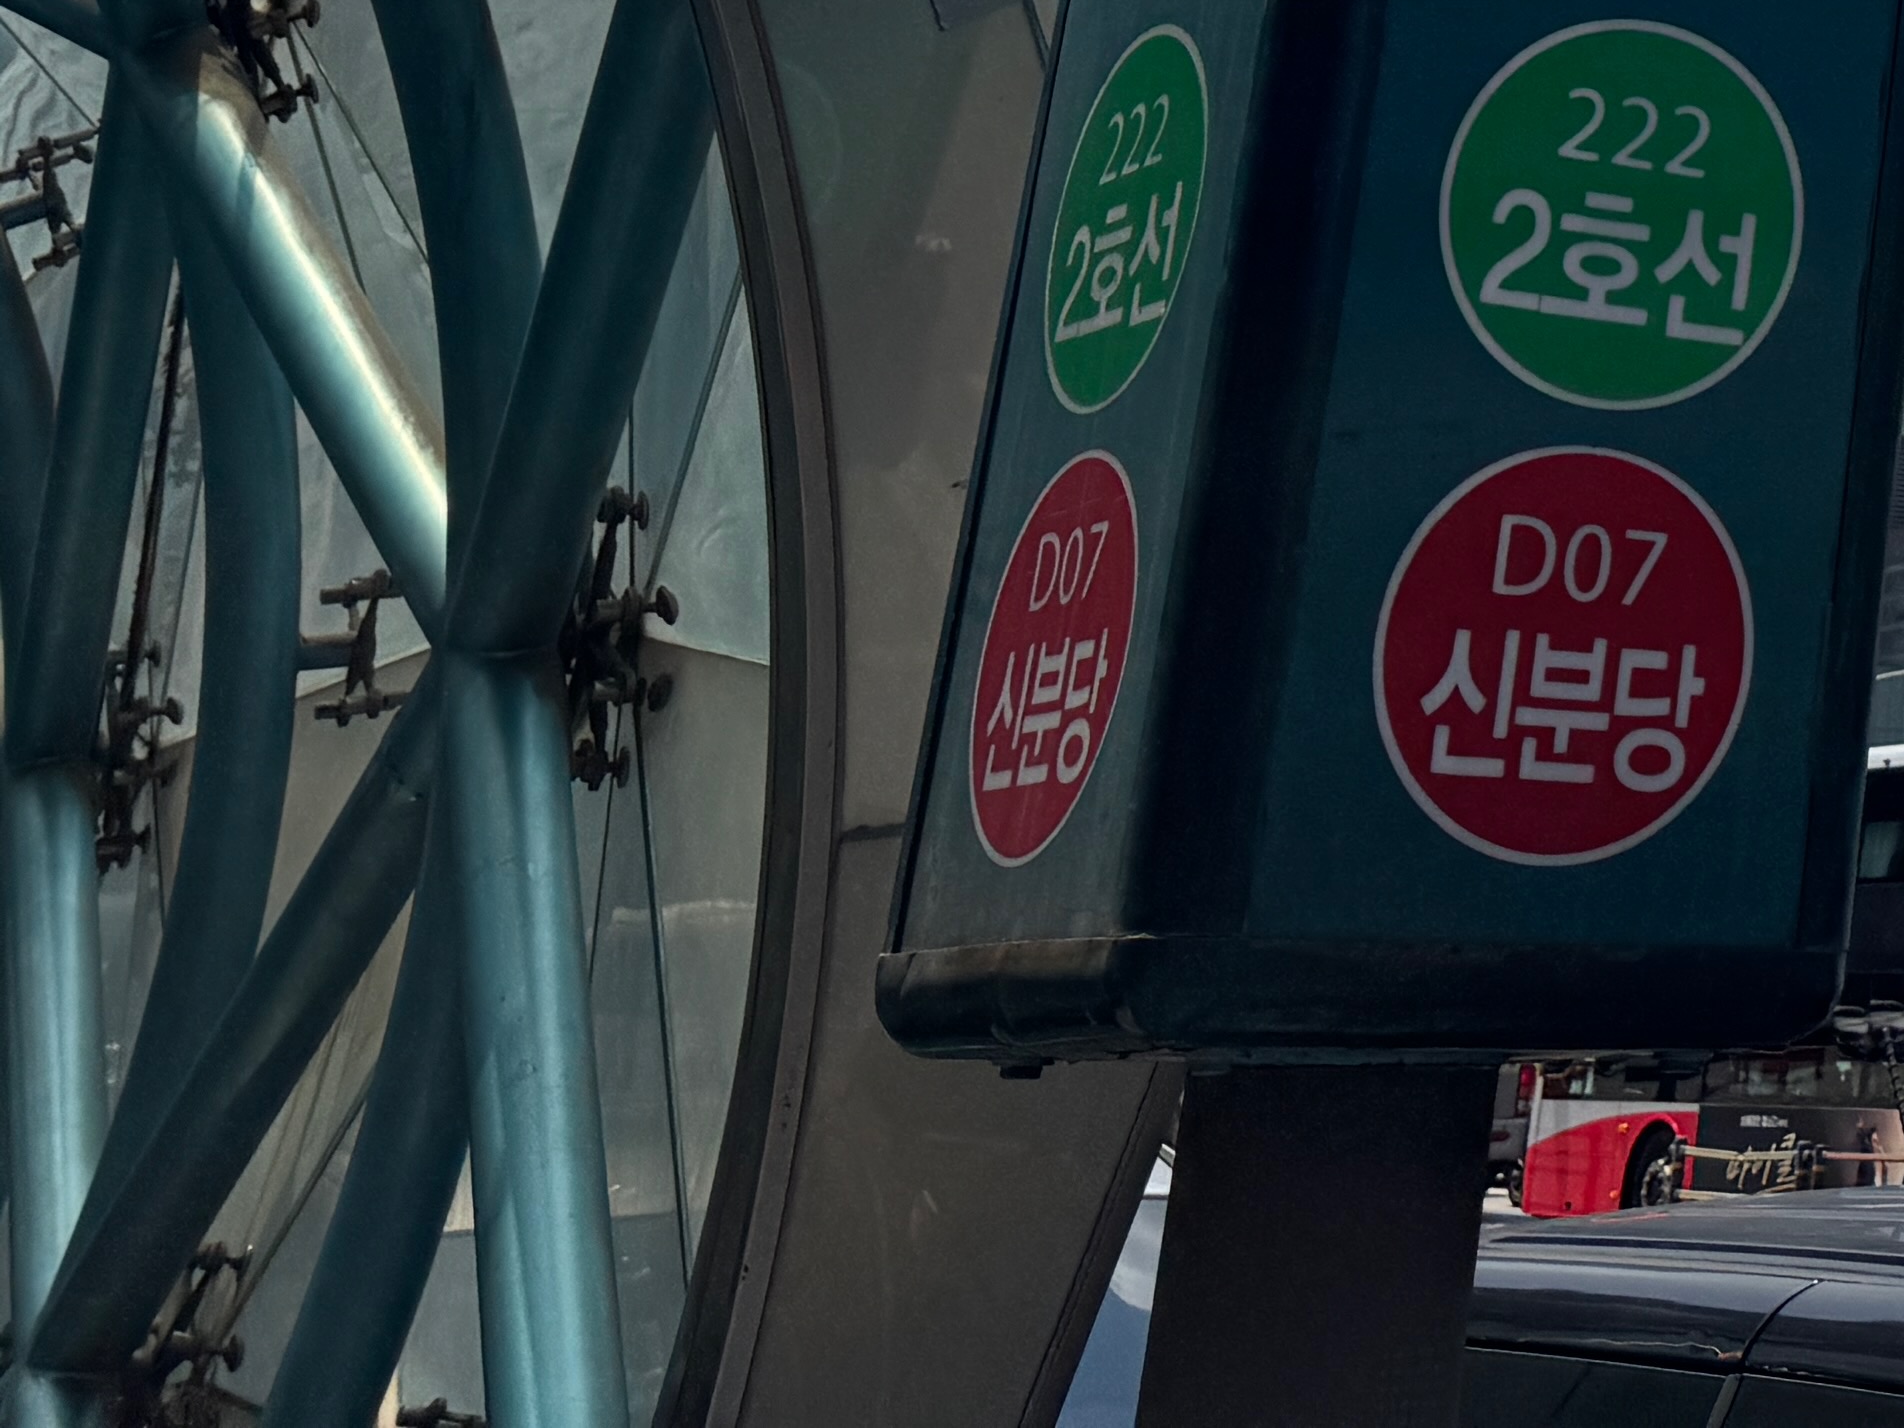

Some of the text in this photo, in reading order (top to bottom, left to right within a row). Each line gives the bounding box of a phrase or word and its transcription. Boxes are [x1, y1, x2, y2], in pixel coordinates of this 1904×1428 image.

[1096, 92, 1172, 184] 222
[1555, 90, 1713, 180] 222
[1053, 179, 1182, 344] 2호선
[1479, 187, 1758, 349] 2호선
[1026, 517, 1111, 604] D07
[1491, 511, 1670, 608] D07
[980, 636, 1111, 795] 신분당
[1421, 632, 1707, 795] 신분당
